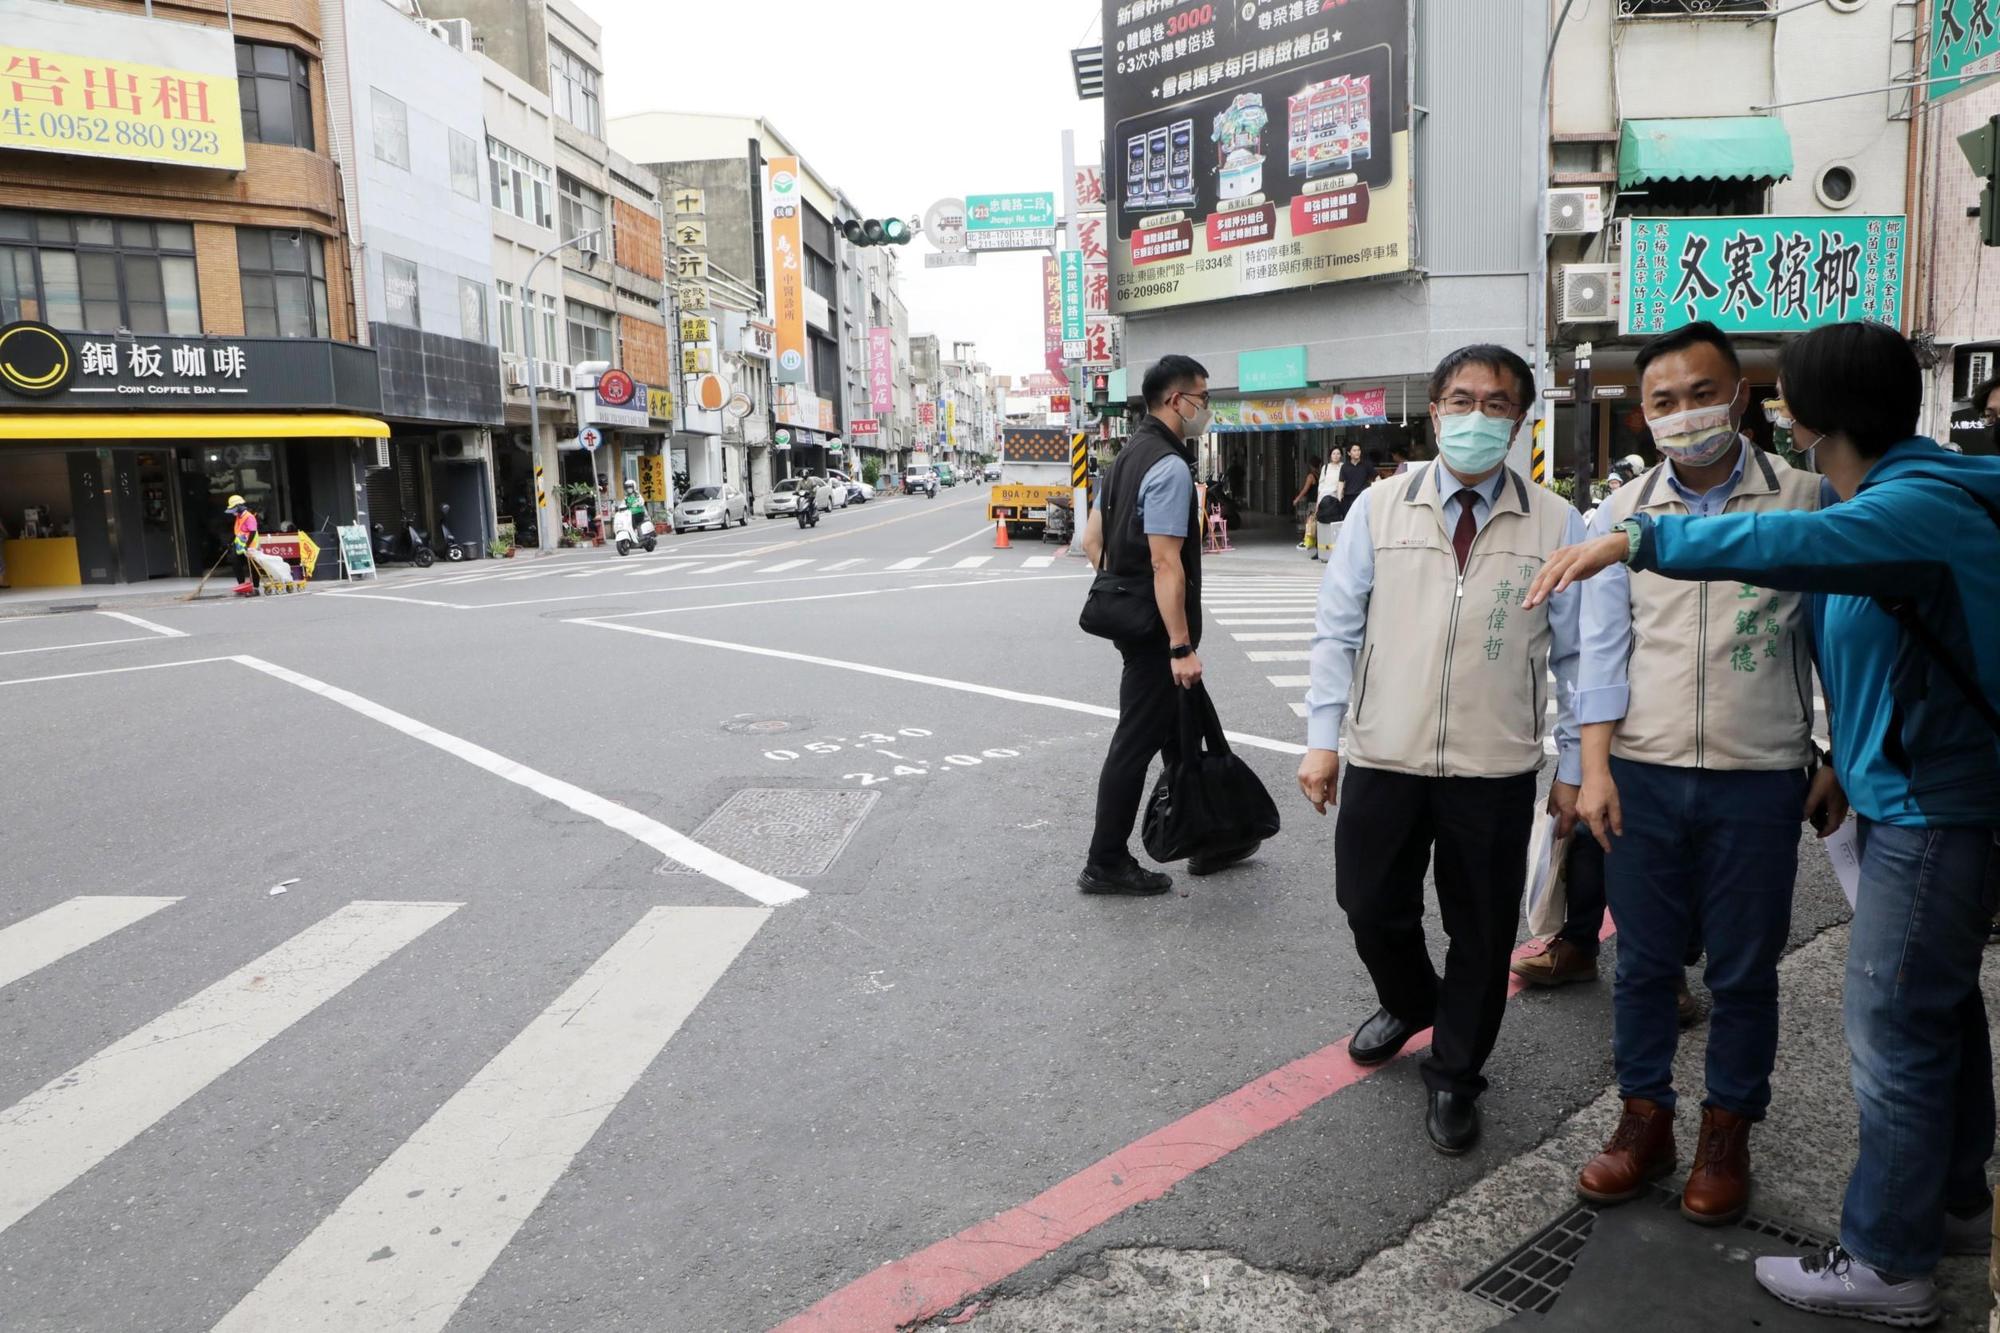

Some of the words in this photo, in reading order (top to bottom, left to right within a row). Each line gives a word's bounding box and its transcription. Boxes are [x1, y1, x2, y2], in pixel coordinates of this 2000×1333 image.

[40, 113, 110, 144] 0952
[115, 121, 164, 150] 880
[171, 129, 220, 155] 923
[1117, 280, 1179, 300] 06-2099687
[1672, 231, 1861, 322] 冬寒檳榔
[80, 341, 247, 379] 銅板咖啡
[1513, 563, 1534, 606] 市長
[1483, 580, 1515, 661] 黃偉哲
